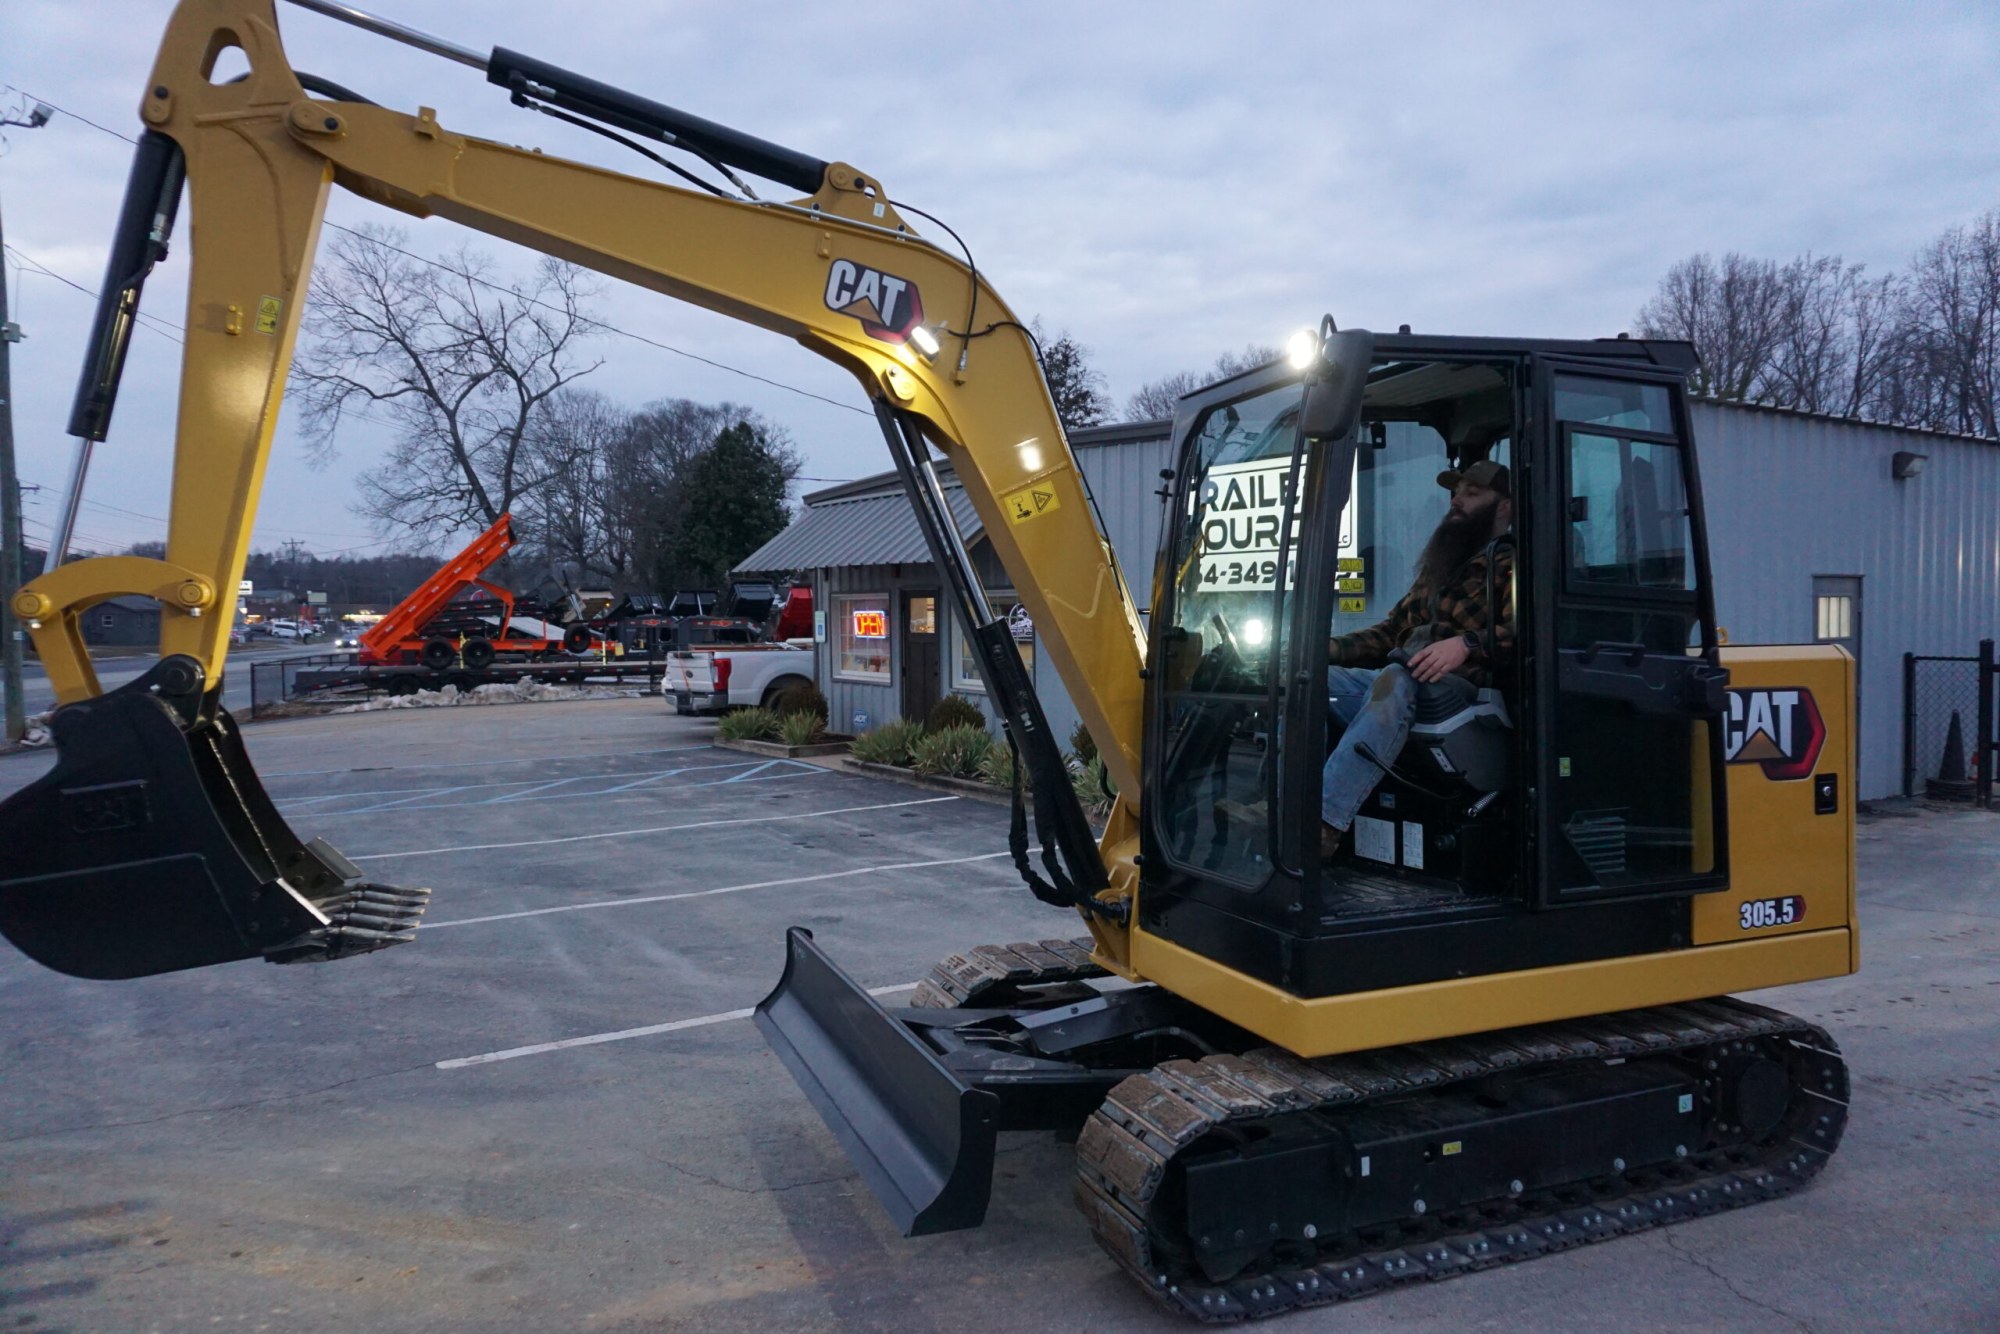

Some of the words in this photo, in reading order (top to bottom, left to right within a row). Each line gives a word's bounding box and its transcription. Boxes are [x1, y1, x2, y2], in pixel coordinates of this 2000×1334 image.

[826, 260, 906, 327] CAT
[856, 613, 885, 636] OPEN
[1725, 690, 1799, 760] CAT
[1740, 898, 1794, 928] 305.5
